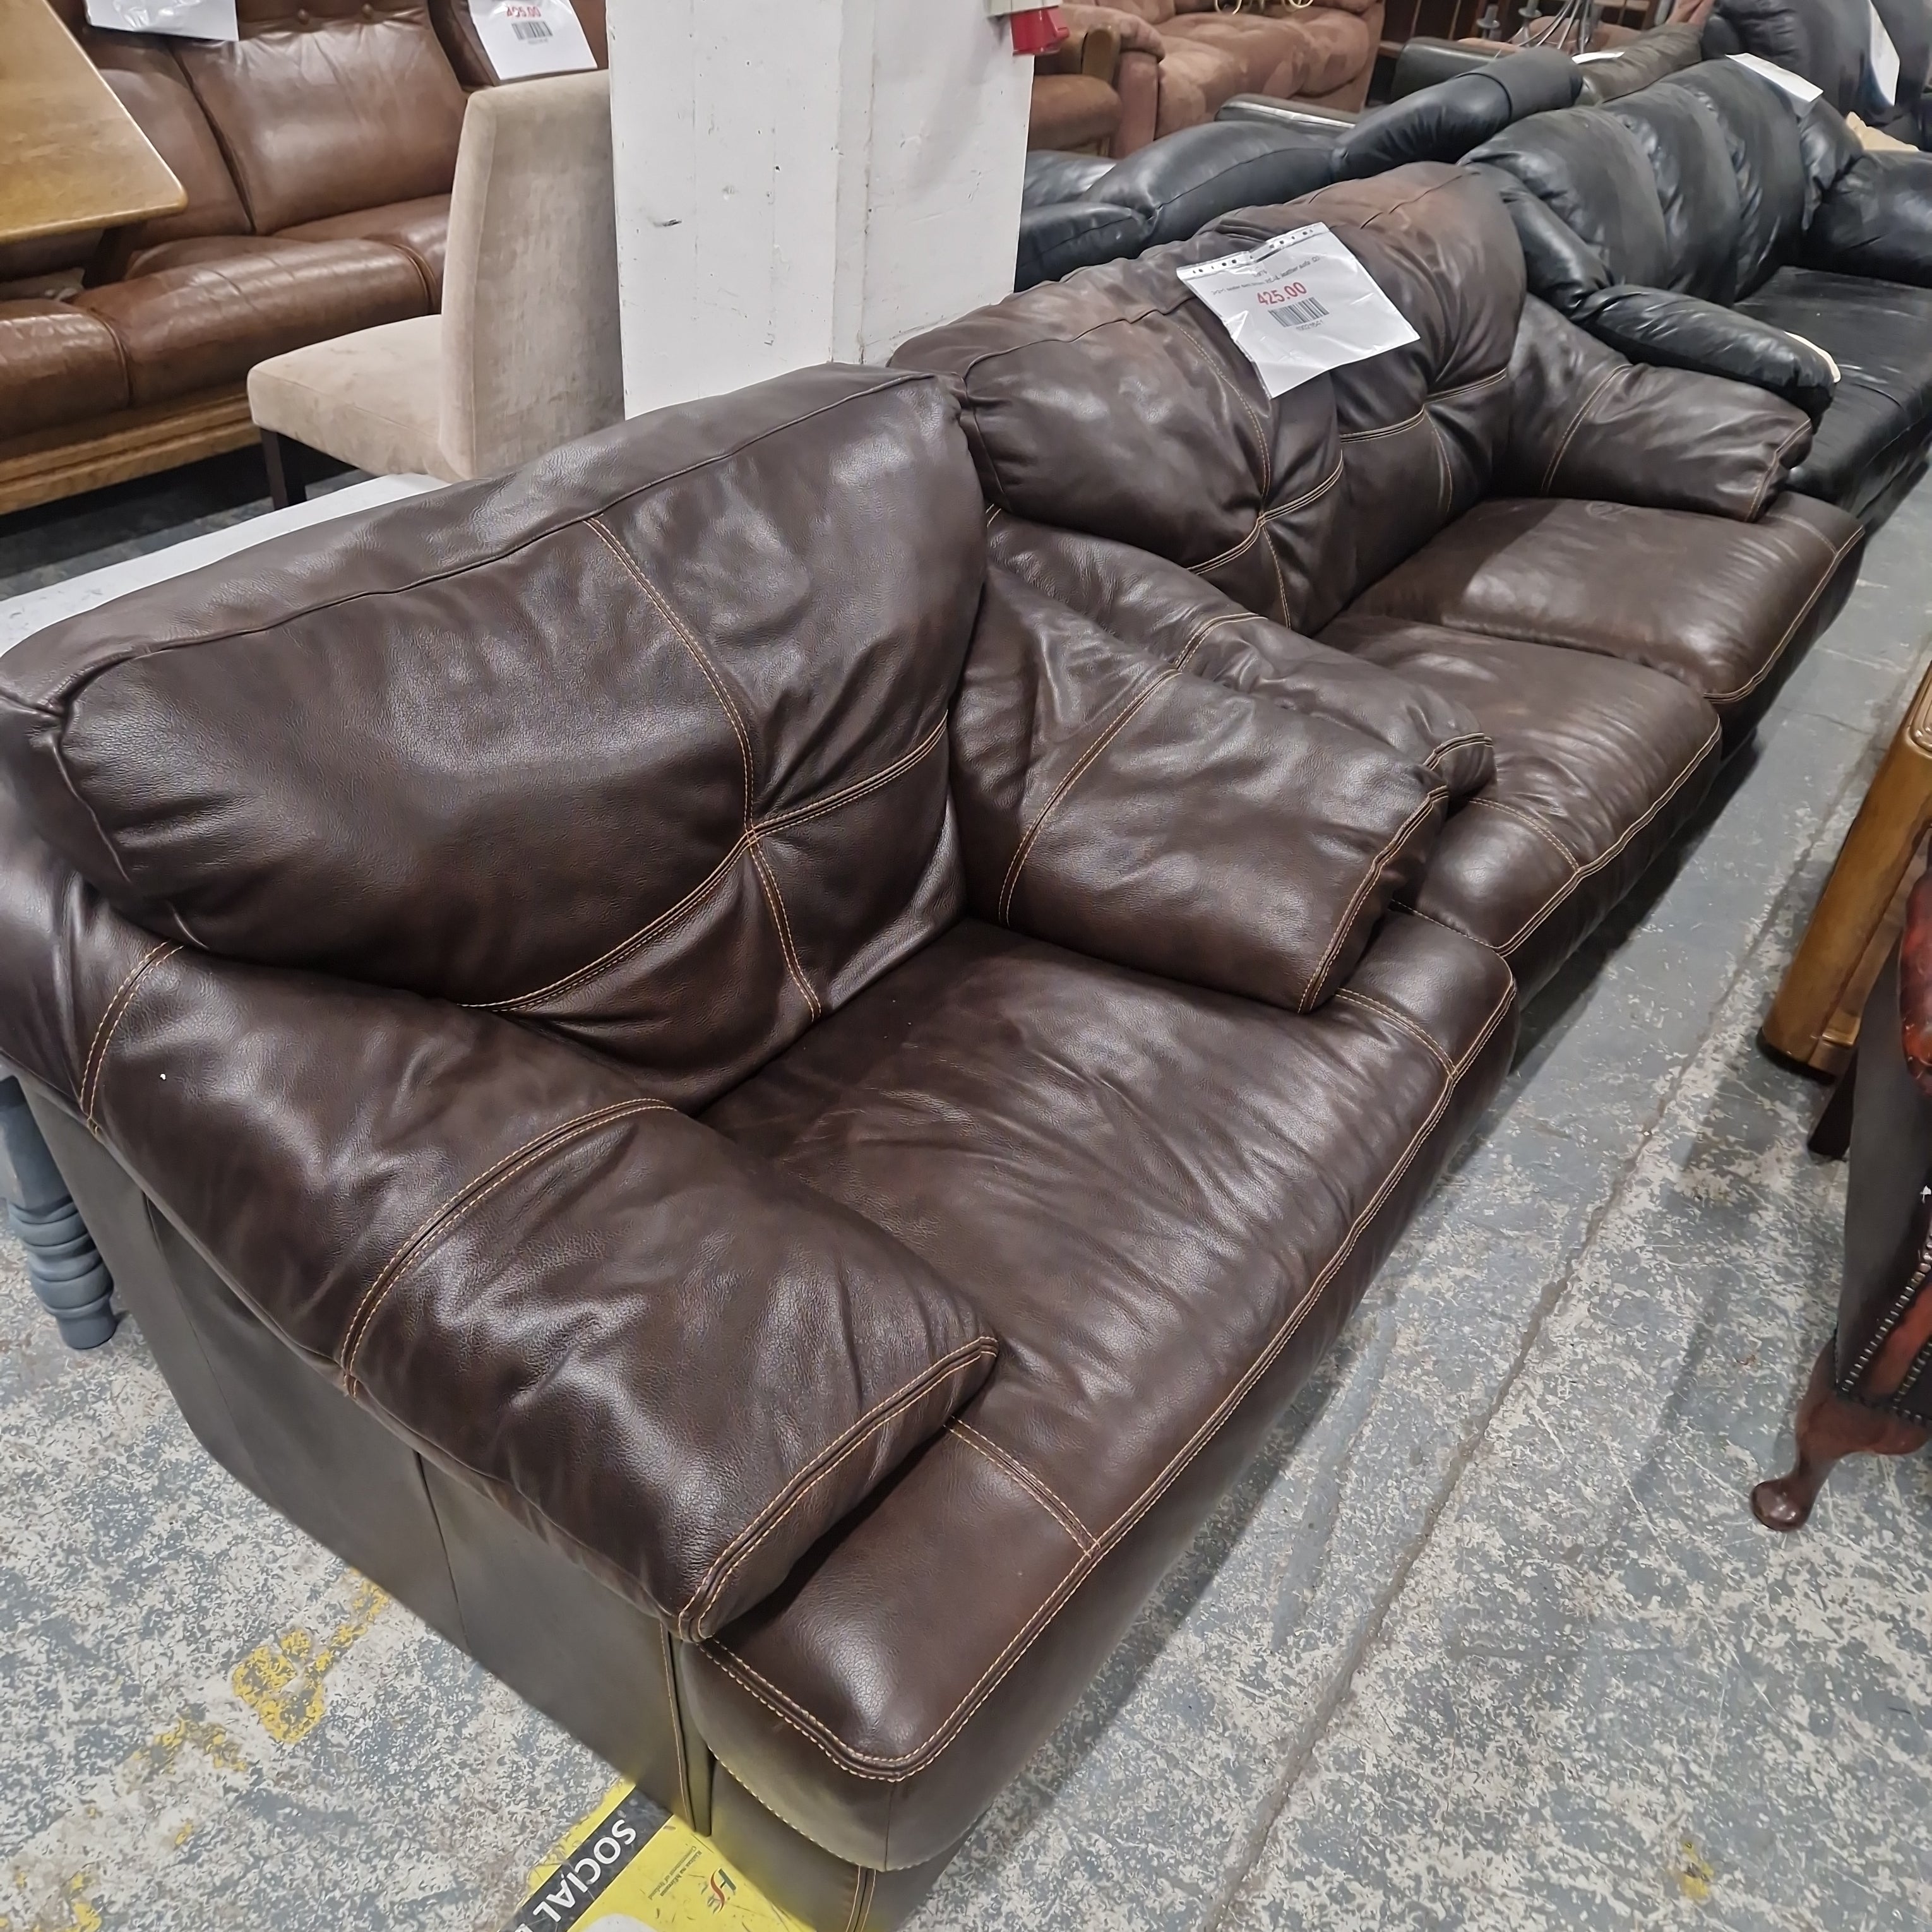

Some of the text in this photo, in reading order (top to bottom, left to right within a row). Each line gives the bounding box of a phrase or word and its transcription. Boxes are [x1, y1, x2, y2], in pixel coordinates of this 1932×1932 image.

[1256, 282, 1307, 305] 425.00
[532, 1819, 636, 1923] SOCIAL
[648, 1846, 698, 1900] Government of Ireland
[701, 1868, 737, 1914] HSE
